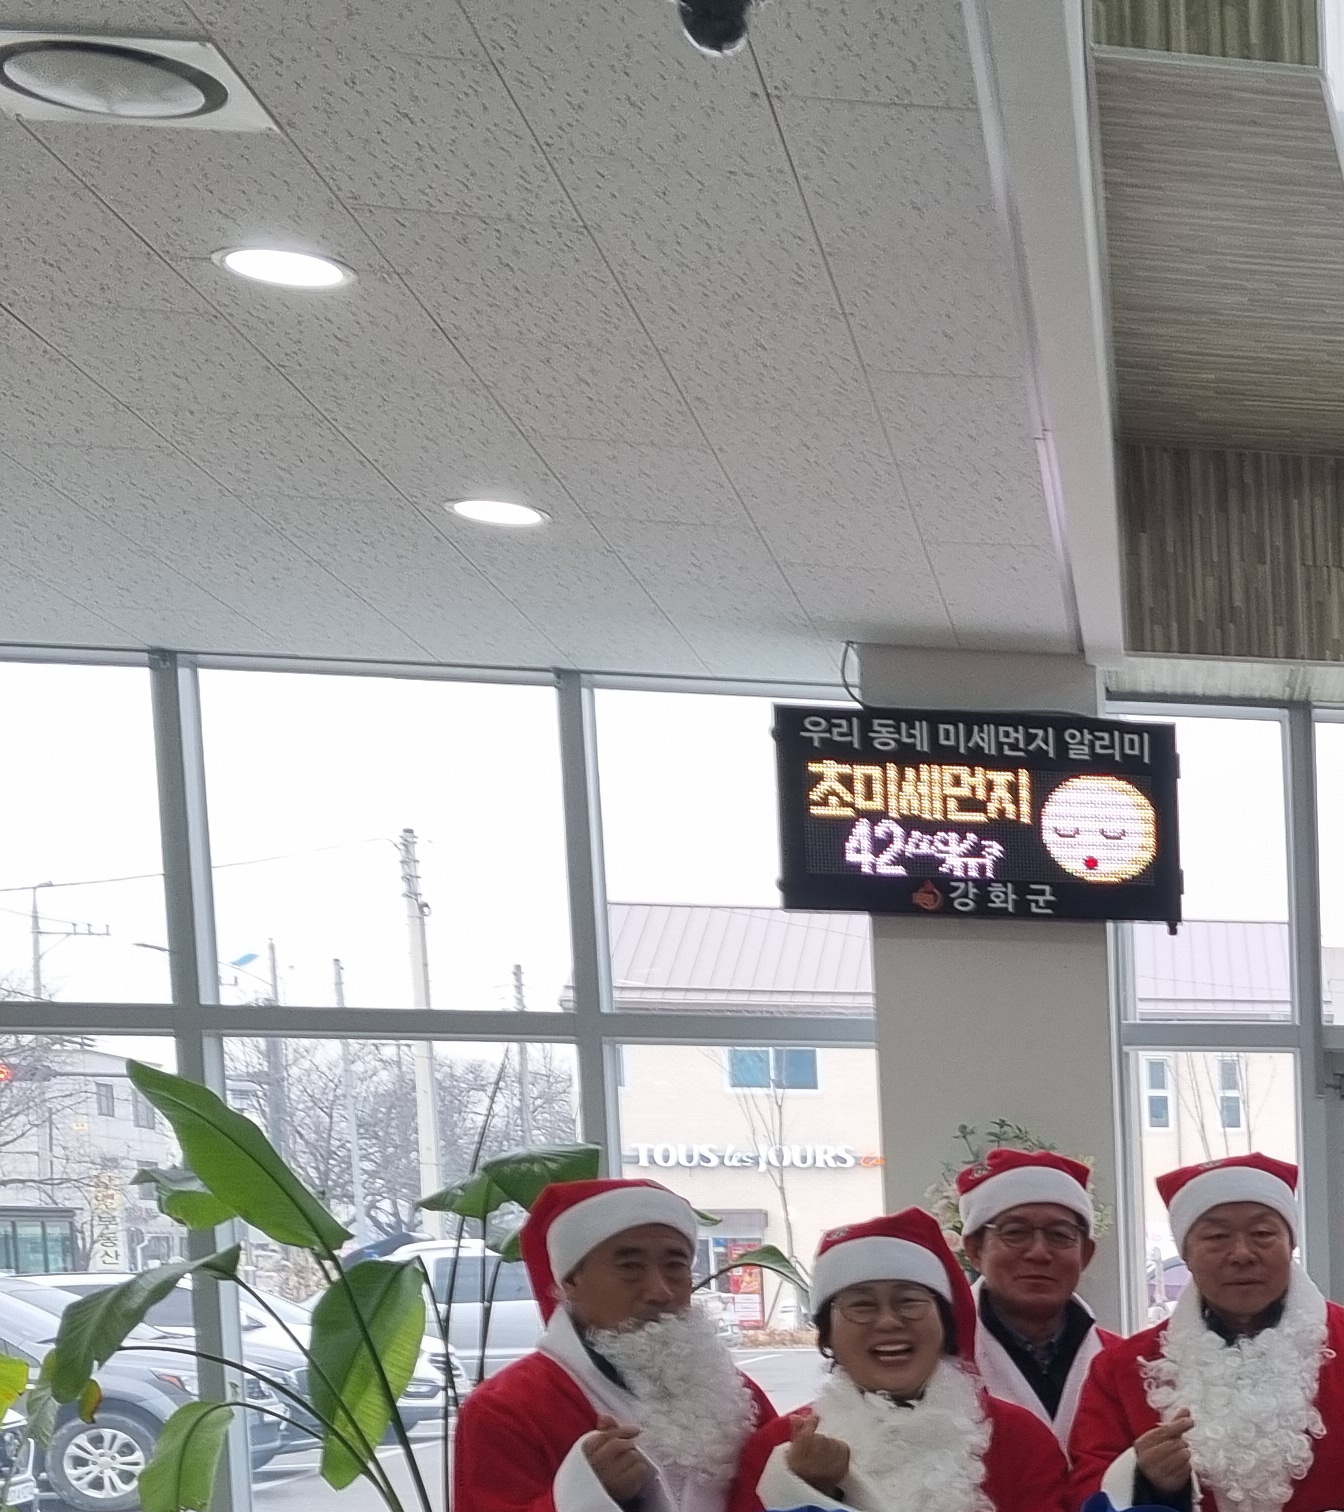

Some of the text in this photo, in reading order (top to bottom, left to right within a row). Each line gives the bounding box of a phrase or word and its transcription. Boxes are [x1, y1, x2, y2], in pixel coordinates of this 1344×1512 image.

[801, 716, 1151, 764] 우리 동네 미세먼지 알리미
[807, 759, 1034, 825] 초미세먼지
[631, 1142, 720, 1168] TOUS
[724, 1145, 755, 1168] les
[757, 1143, 856, 1173] JOURS
